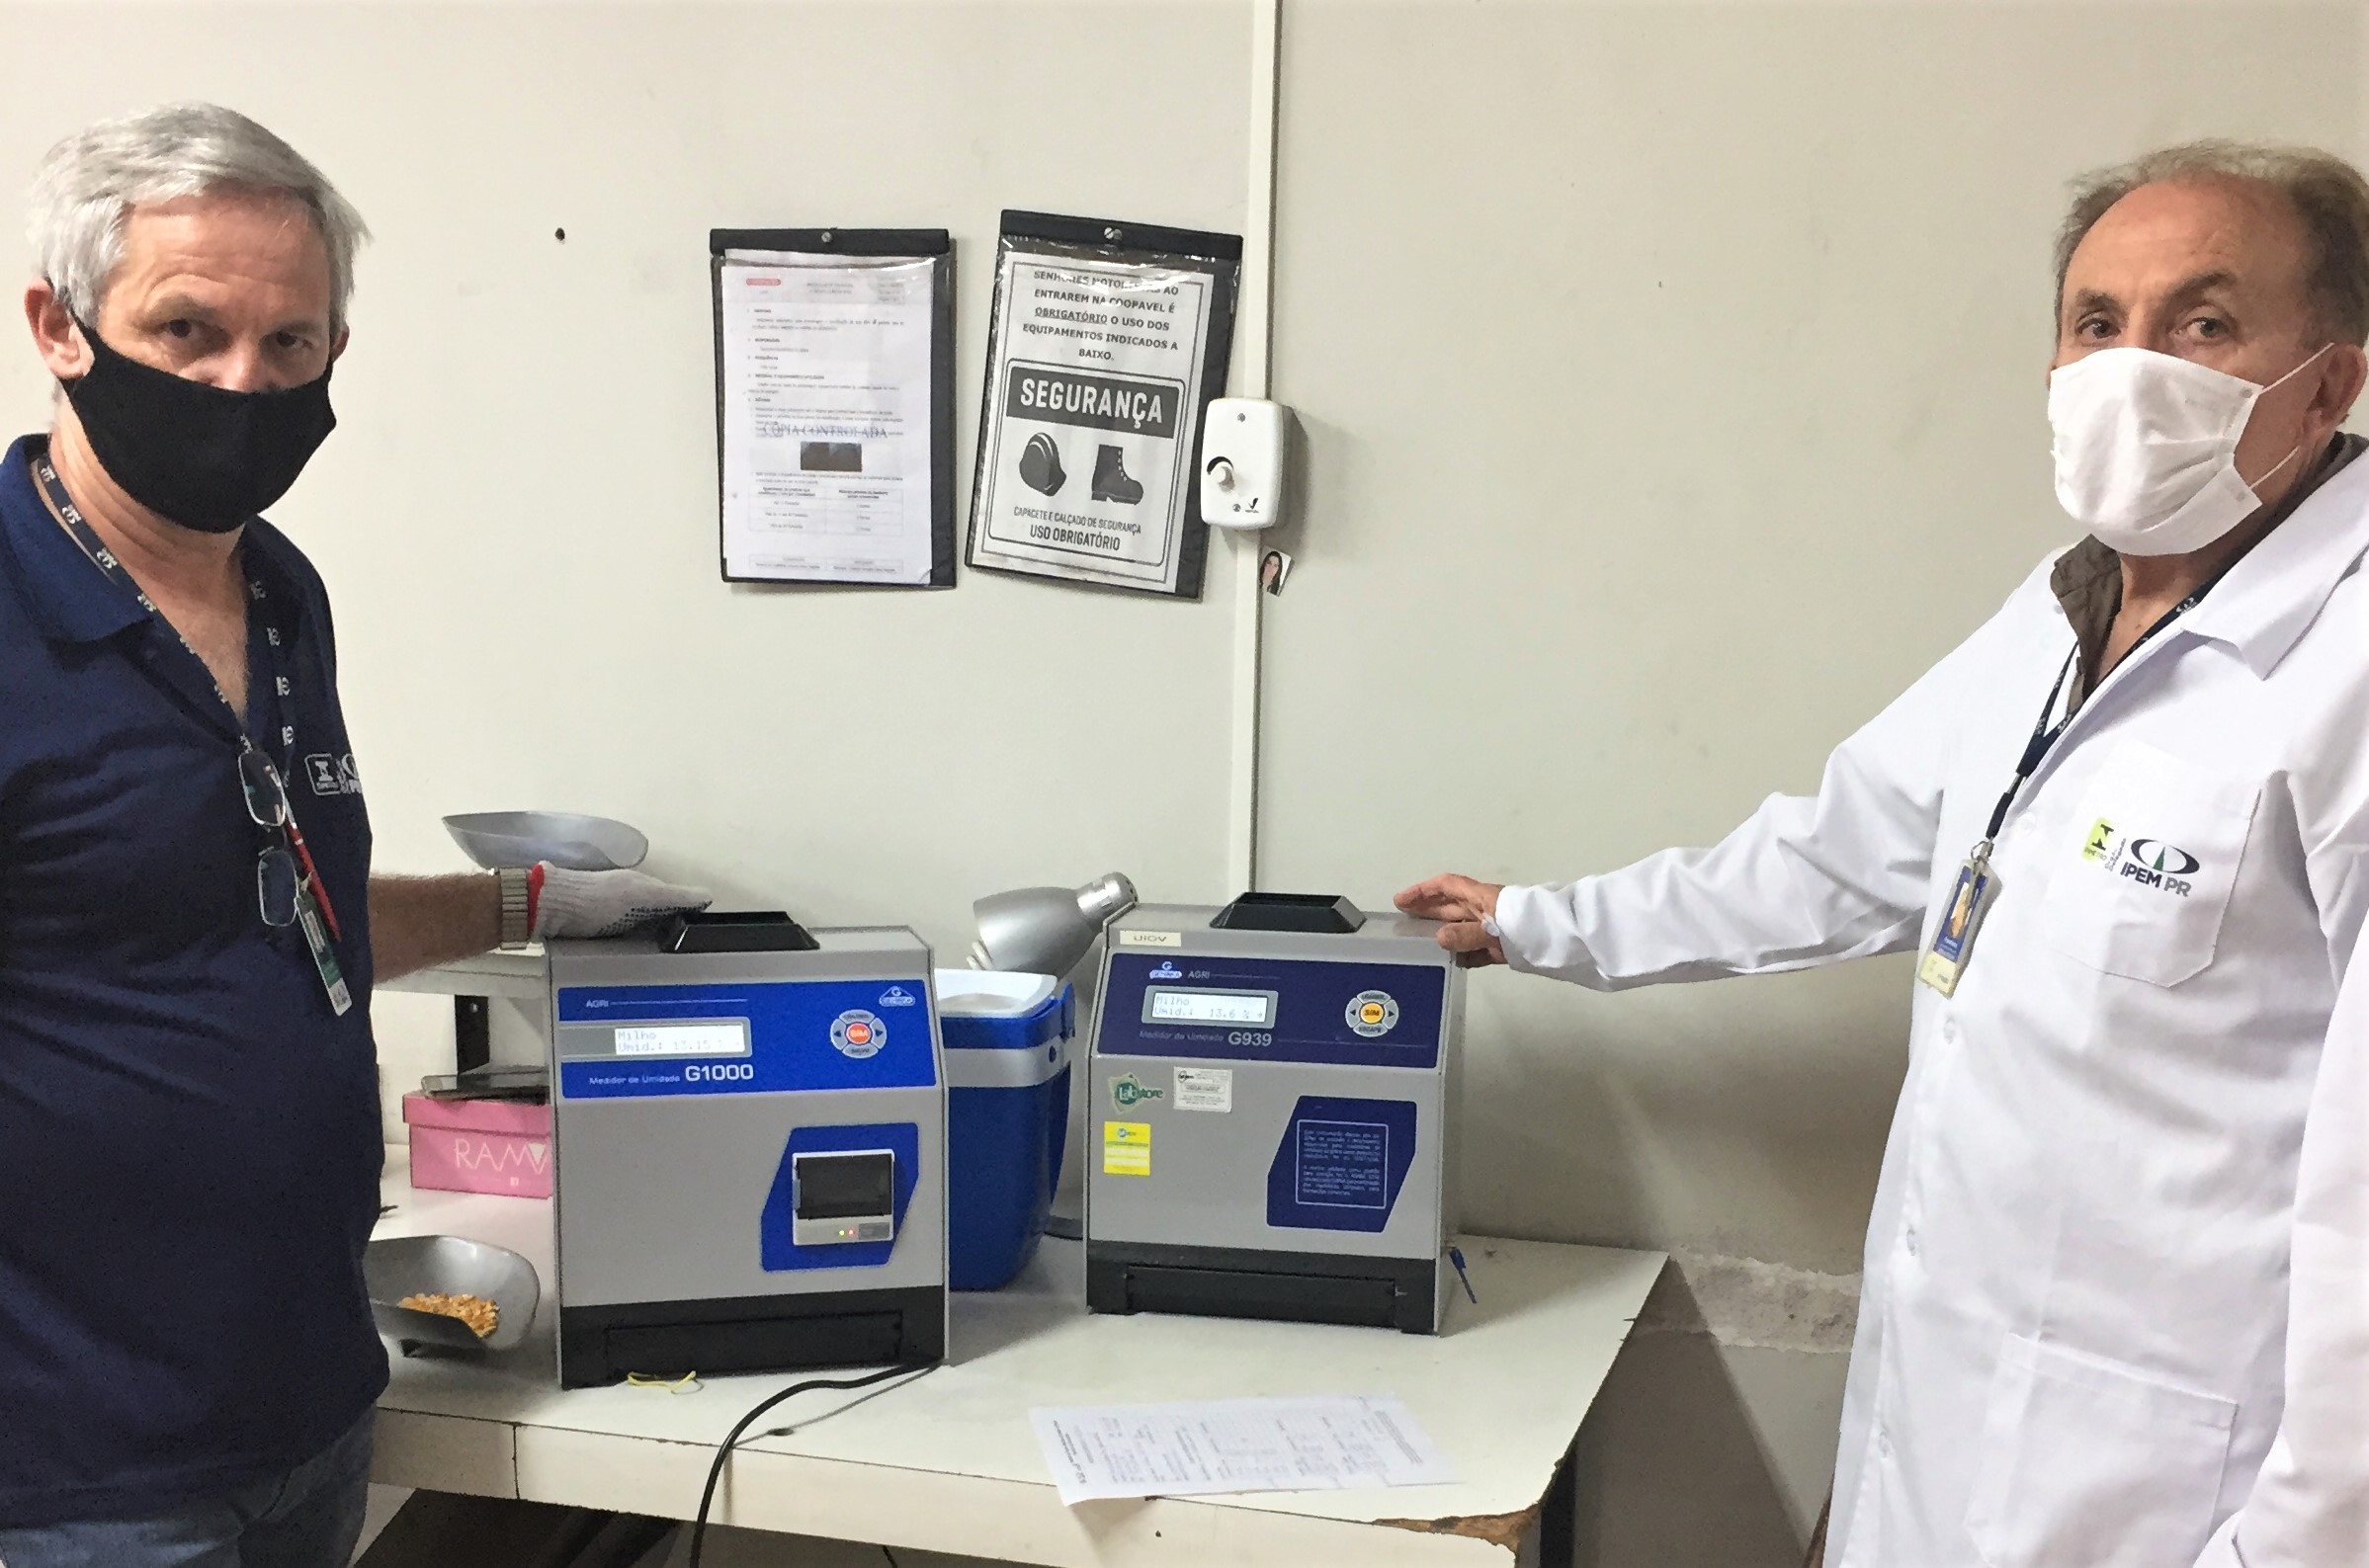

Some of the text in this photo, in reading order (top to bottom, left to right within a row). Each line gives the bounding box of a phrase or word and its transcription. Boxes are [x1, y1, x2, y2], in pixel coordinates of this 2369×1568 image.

[1033, 270, 1089, 286] SENHES
[1162, 286, 1179, 296] AO
[1034, 289, 1176, 314] ENTRAREM NA COOPAVEL É
[1034, 306, 1170, 331] OBRIGATÓRIO O USO DOS
[1022, 323, 1179, 351] EQUIPAMENTOS INDICADOS A
[1078, 348, 1115, 361] BAIXO.
[1020, 377, 1162, 429] SEGURANÇA
[1013, 506, 1142, 536] CAPACETE E CALÇADO DE SEGURANÇA
[1030, 524, 1121, 551] USO OBRIGATÓRIO
[2120, 861, 2192, 897] IPEM PR
[1188, 970, 1211, 979] AGRI
[585, 999, 610, 1008] AGRI
[1155, 996, 1190, 1006] Milho
[1209, 1008, 1235, 1019] 13.6
[618, 1031, 657, 1040] Milho
[1227, 1032, 1273, 1047] G939
[685, 1064, 754, 1082] G1000
